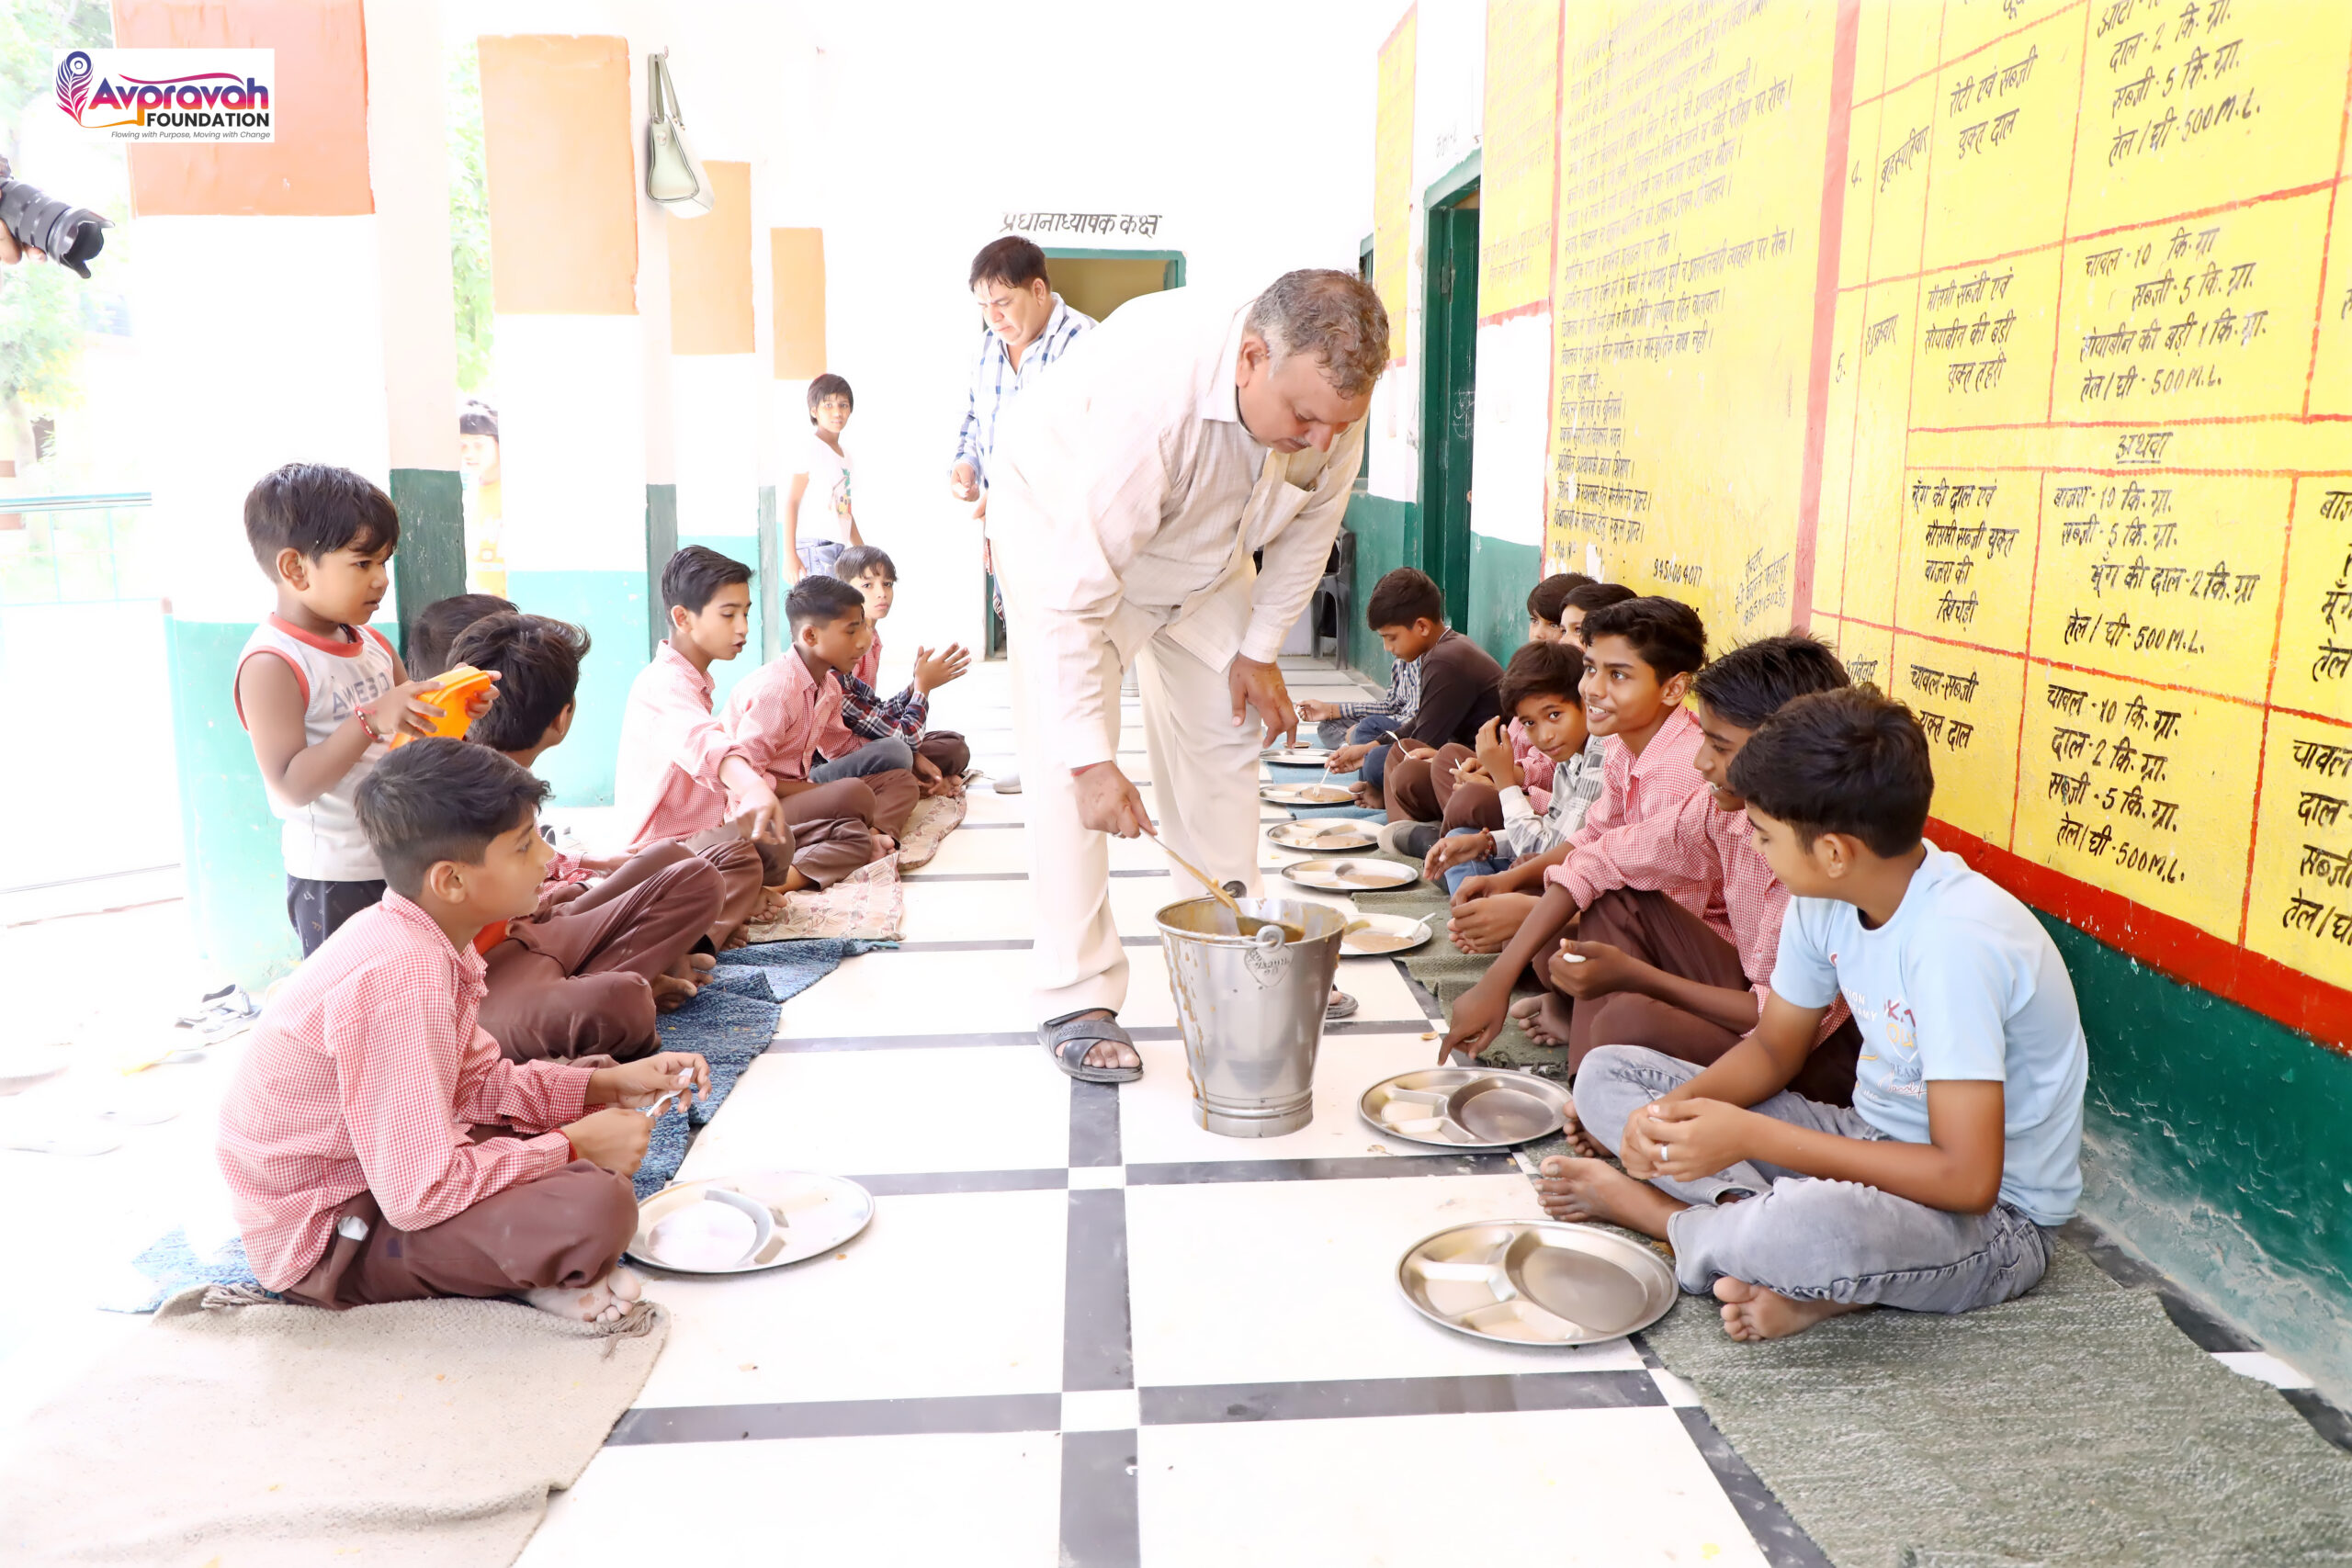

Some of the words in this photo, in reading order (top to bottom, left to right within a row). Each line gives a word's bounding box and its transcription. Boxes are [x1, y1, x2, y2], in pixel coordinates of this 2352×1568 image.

[2110, 32, 2143, 73] दाल
[1951, 76, 1974, 118] रोटी
[2162, 67, 2176, 97] 5
[1755, 90, 1766, 117] पर
[1991, 108, 2019, 146] दाल
[1757, 237, 1769, 261] पर
[2086, 248, 2123, 276] चावल
[2116, 432, 2173, 459] अथवा
[1950, 485, 1975, 514] दाल
[2124, 556, 2150, 590] की
[2151, 567, 2187, 597] दाल
[2047, 684, 2088, 717] चावल
[1947, 720, 1974, 752] दाल
[2052, 727, 2093, 762] दाल
[2049, 772, 2091, 807] सब्जी
[2298, 791, 2349, 827] दाल
